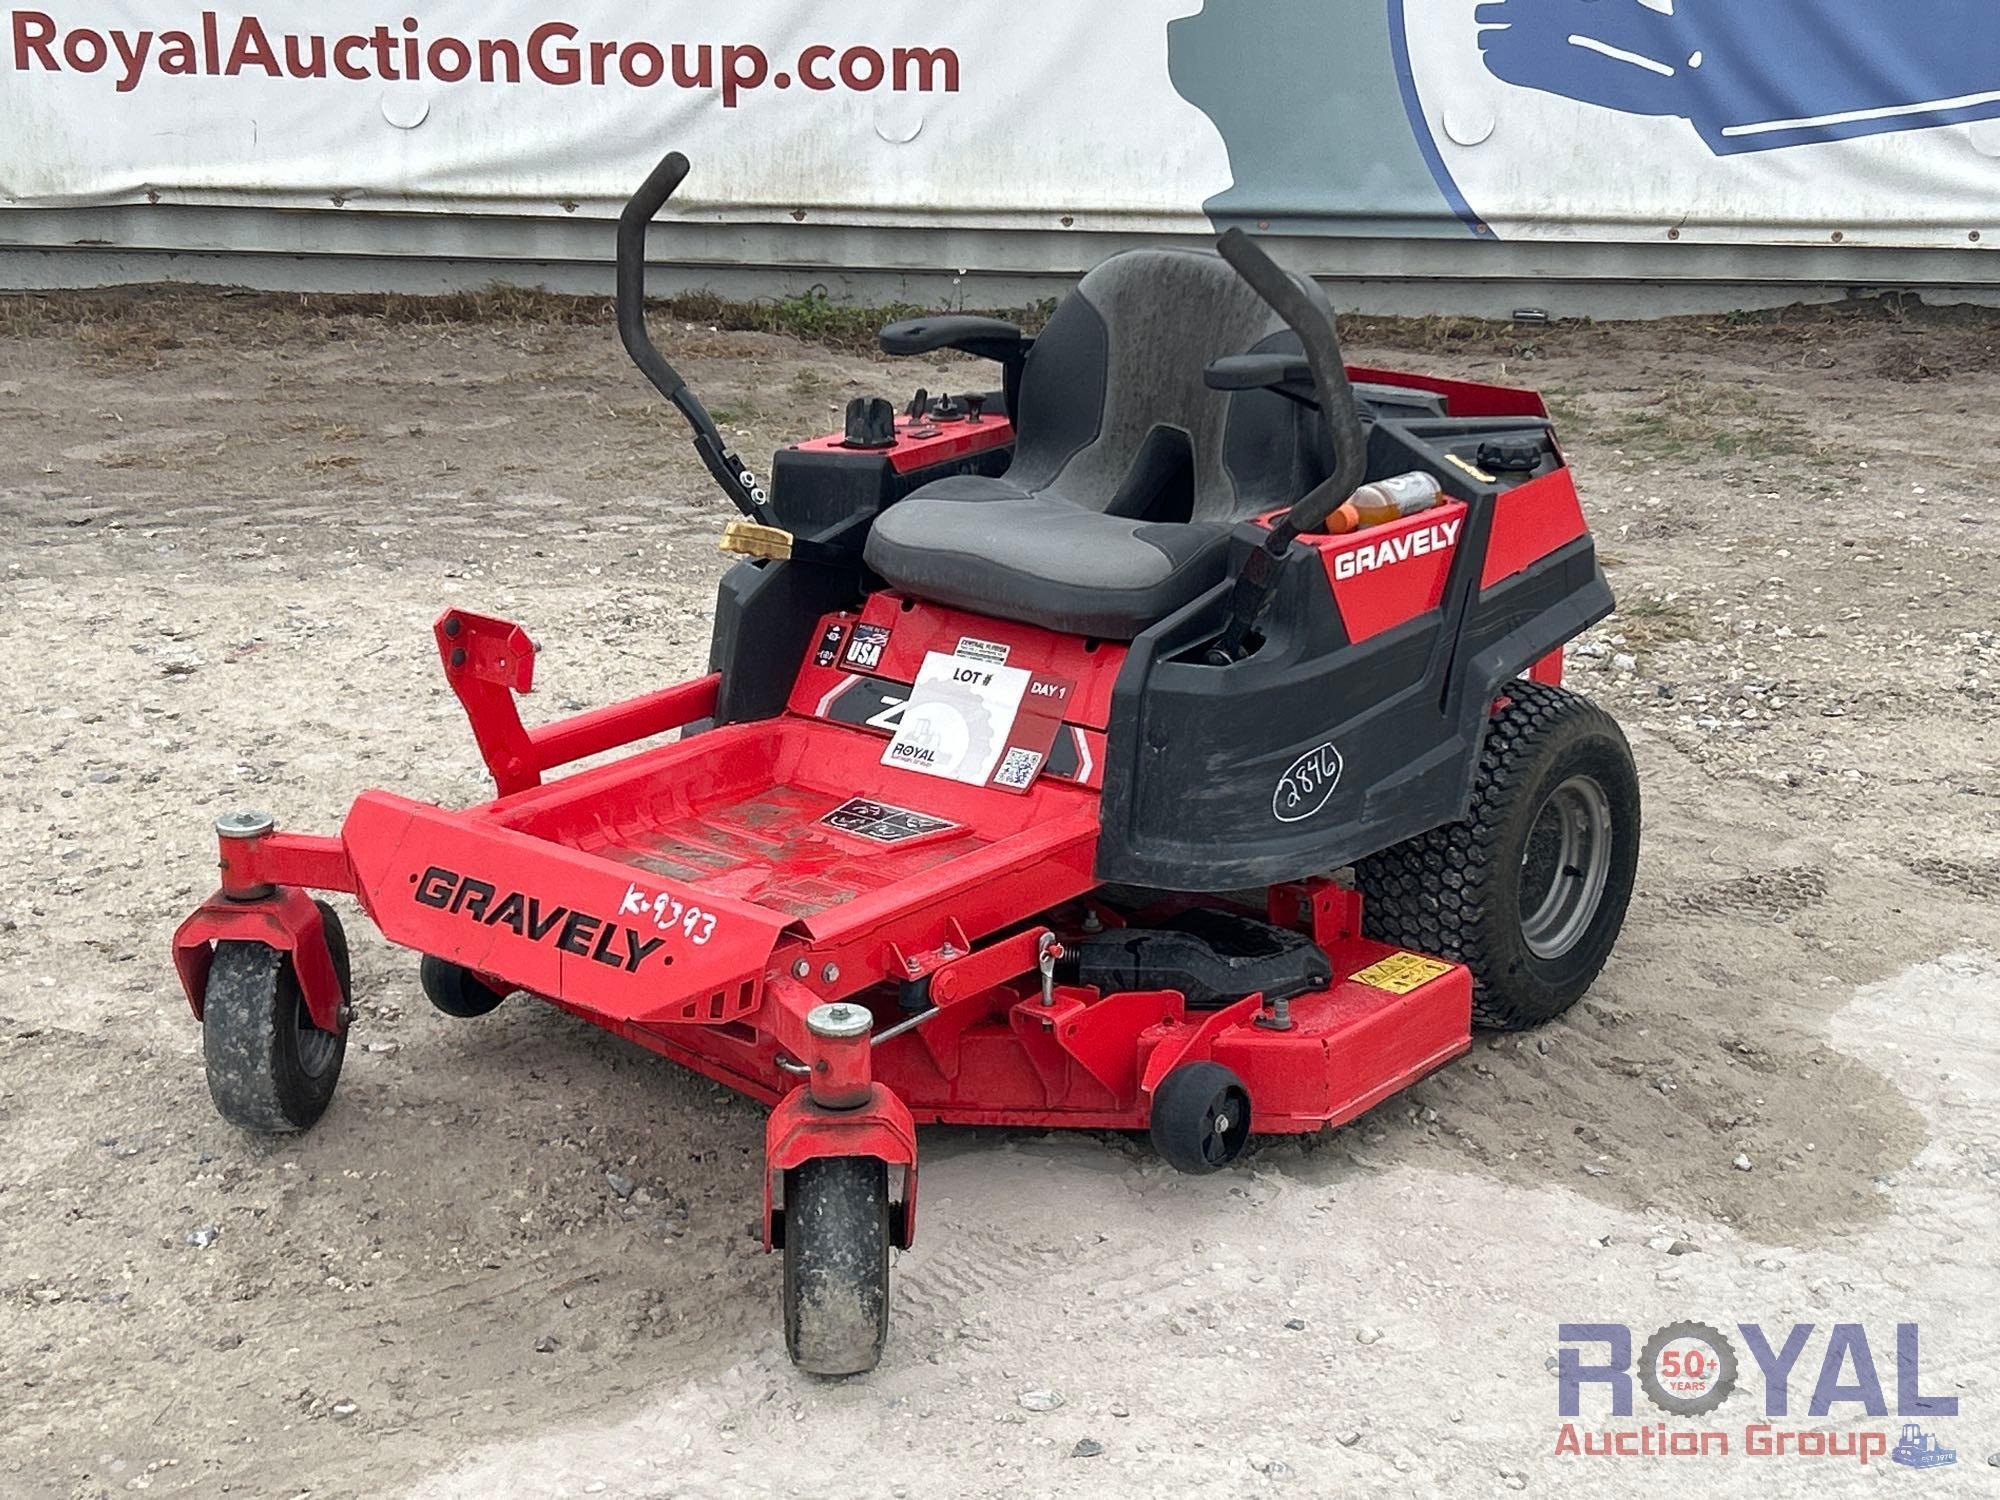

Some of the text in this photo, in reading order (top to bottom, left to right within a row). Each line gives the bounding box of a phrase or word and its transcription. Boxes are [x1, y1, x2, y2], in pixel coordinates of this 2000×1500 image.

[11, 10, 960, 108] RoyalAuctionGroup.com
[1334, 518, 1461, 582] GRAVELY
[846, 640, 882, 667] USA
[952, 668, 994, 686] LOT #
[1030, 681, 1066, 699] DAY 1
[893, 742, 936, 762] ROYAL
[1286, 749, 1337, 808] 2846
[415, 866, 667, 974] GRAVELY
